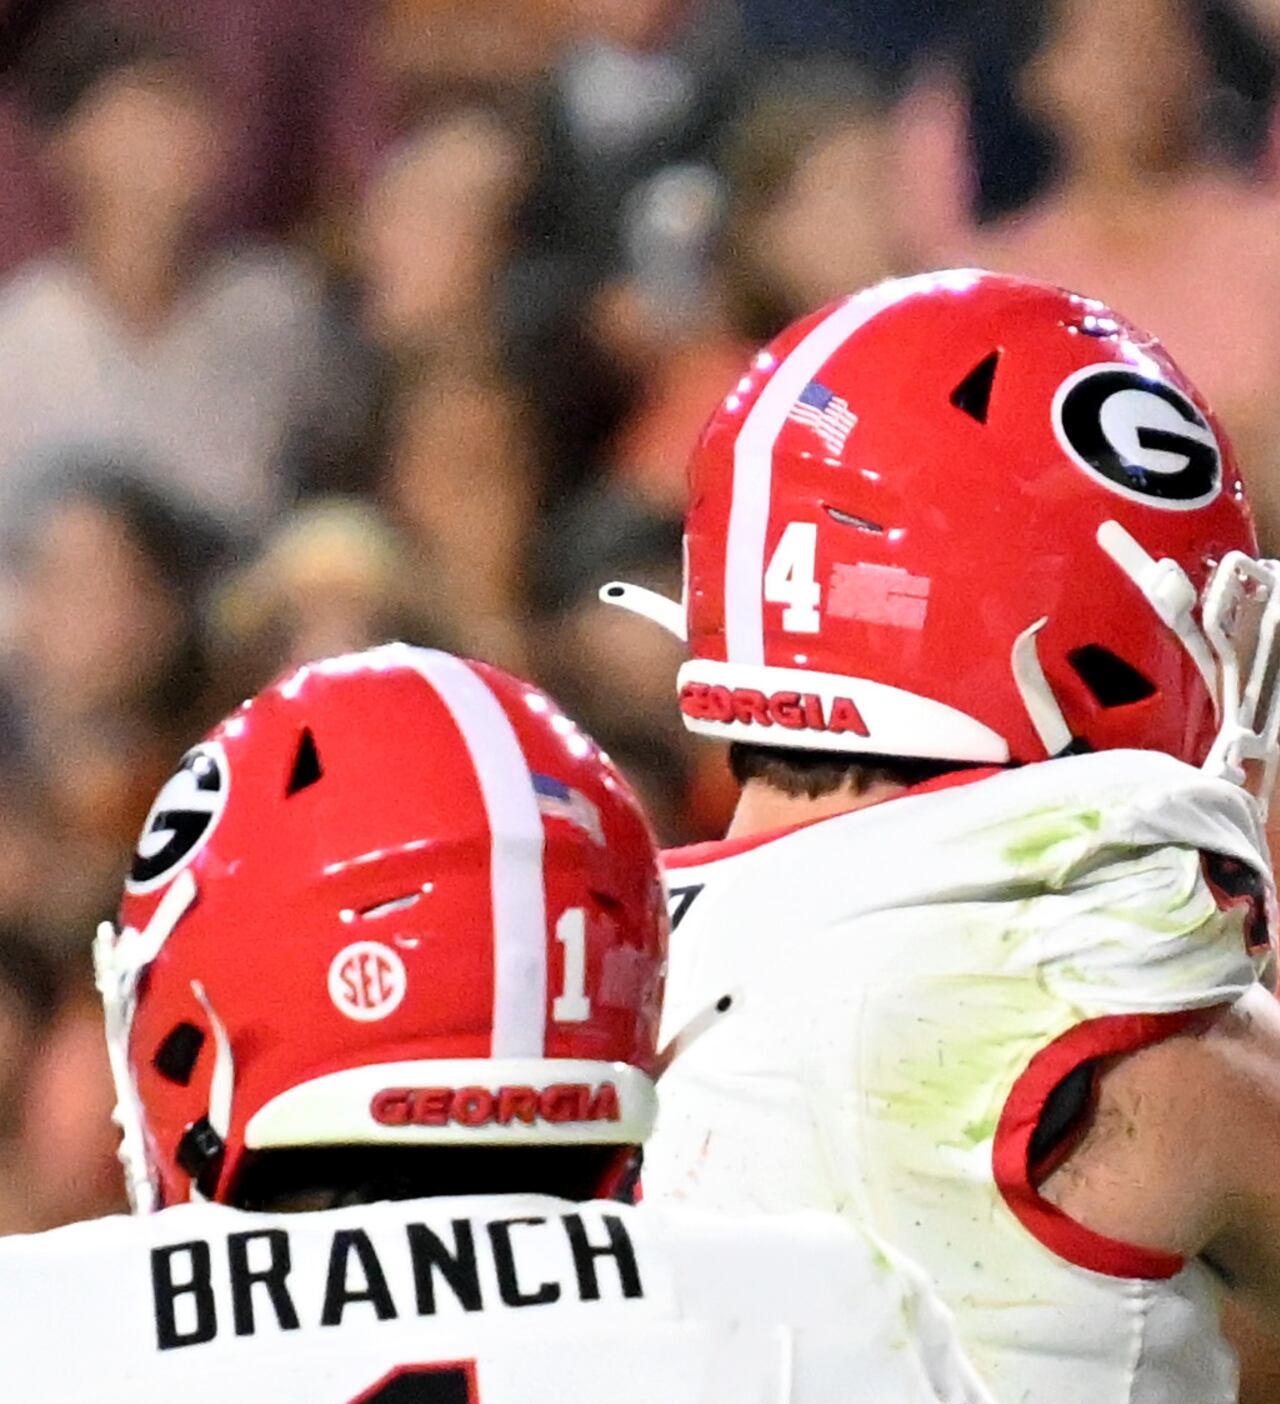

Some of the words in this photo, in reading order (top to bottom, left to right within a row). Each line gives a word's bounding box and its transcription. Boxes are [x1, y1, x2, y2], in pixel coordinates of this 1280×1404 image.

[1061, 370, 1222, 500] G
[765, 522, 821, 632] 4
[339, 953, 394, 1008] SEC
[554, 908, 590, 1021] 1
[370, 1081, 620, 1126] GEORGIA
[151, 1213, 644, 1350] BRANCH
